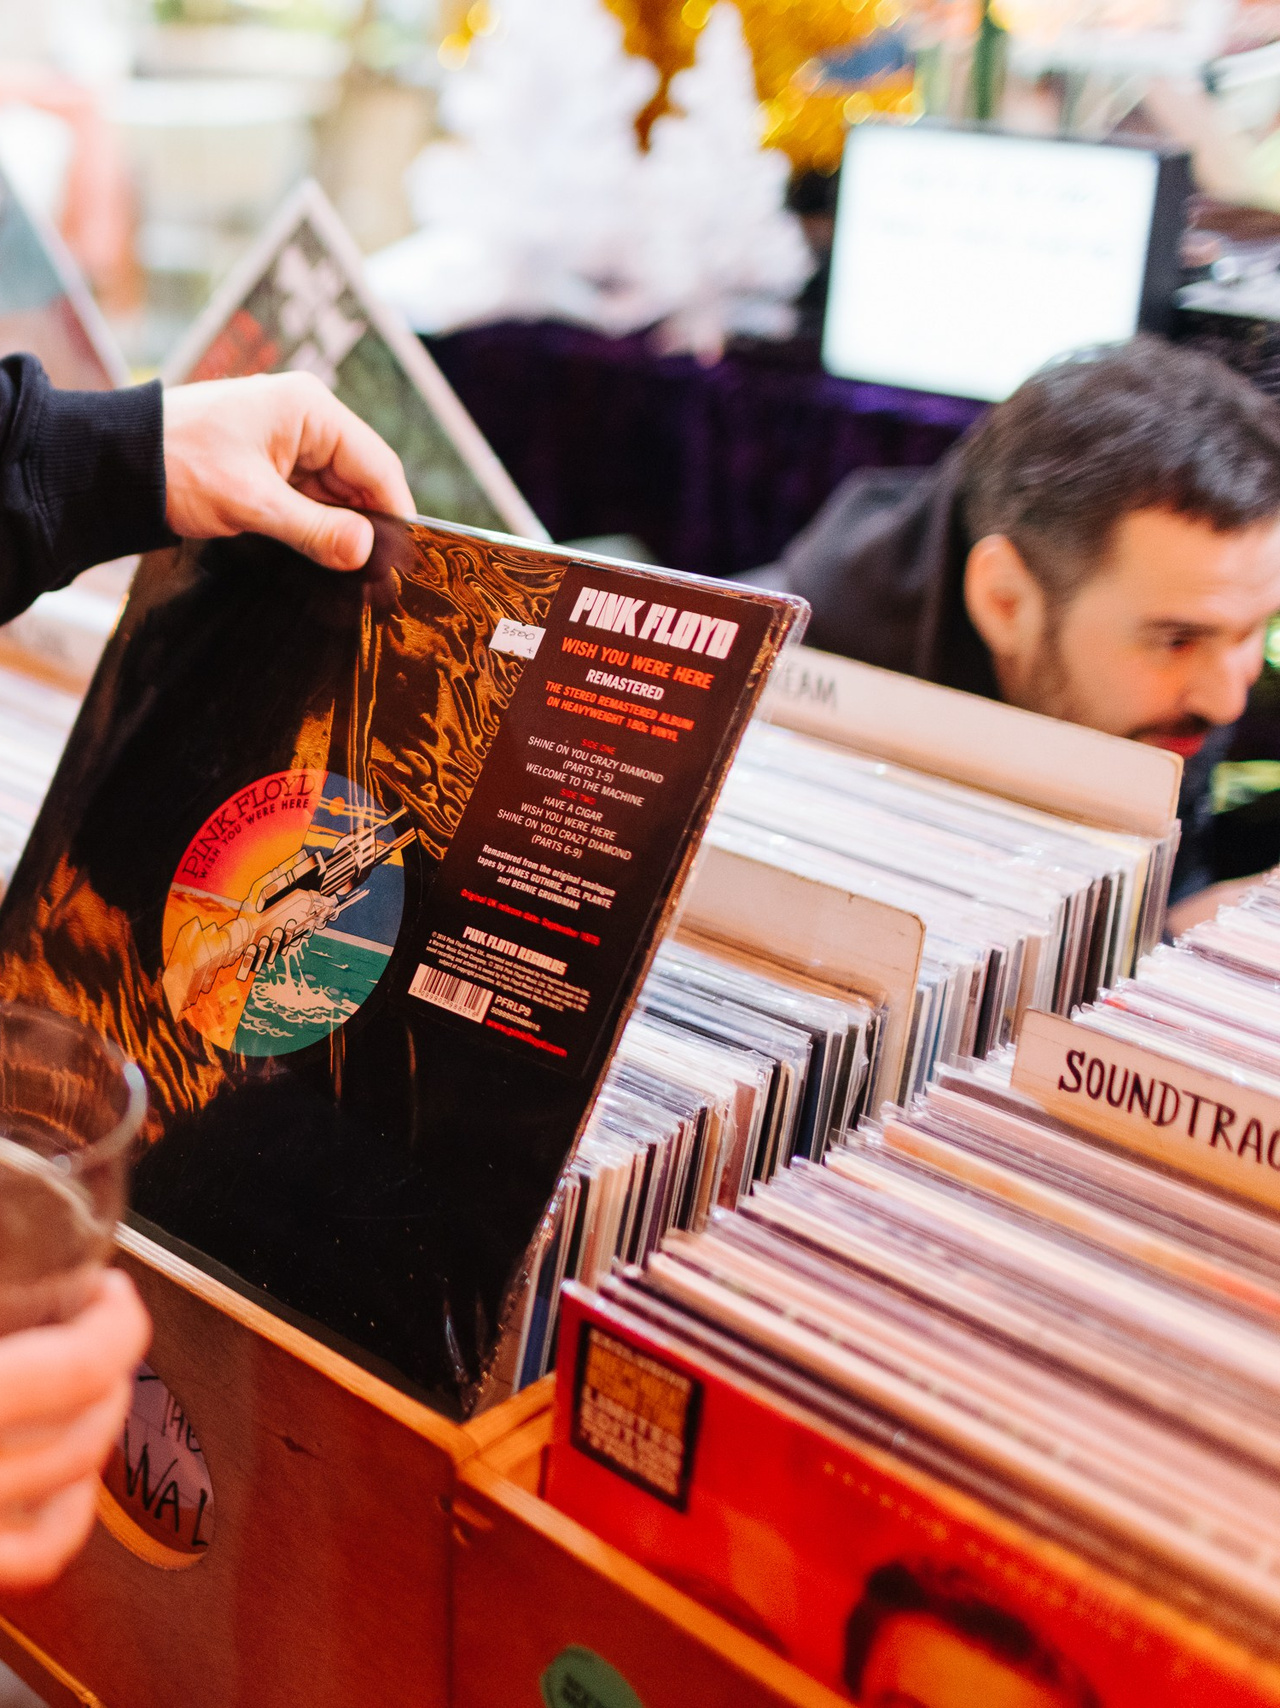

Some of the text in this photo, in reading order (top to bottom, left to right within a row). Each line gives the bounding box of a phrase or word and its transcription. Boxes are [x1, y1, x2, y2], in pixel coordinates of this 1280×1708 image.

[502, 624, 535, 641] 3500
[569, 586, 740, 660] PINK FLOYD
[561, 637, 715, 690] WISH YOU WERE HERE
[585, 669, 665, 700] REMASTERED
[545, 681, 695, 731] THE STEREO REMASTERED ALBUM
[546, 696, 561, 707] ON
[560, 700, 625, 725] HEAVYWEIGHT
[650, 725, 679, 742] VINYL
[528, 736, 664, 784] SHINE ON YOU CRAZY DIAMOND
[581, 738, 616, 755] SIDE ONE
[526, 763, 645, 807] WELCOME TO THE MACHINE
[562, 760, 614, 783] (PARTS 1-5)
[182, 774, 315, 878] PINK FLOYD
[520, 802, 617, 841] WISH YOU WERE HERE
[543, 796, 603, 822] HAVE A CIGAR
[198, 799, 309, 878] WISH YOU WERE HERE
[497, 808, 632, 860] SHINE ON YOU CRAZY DIAMOND
[531, 834, 583, 859] (PARTS 6-9)
[477, 855, 613, 909] tapes by JAMES GUTHRIE, JOEL PLANTE
[482, 844, 616, 897] Remastered from the original analogue
[497, 876, 580, 910] and BERNIE GRUNDMAN
[462, 925, 568, 976] PINK FLOYD RECORDS
[494, 995, 532, 1017] PFRLP9
